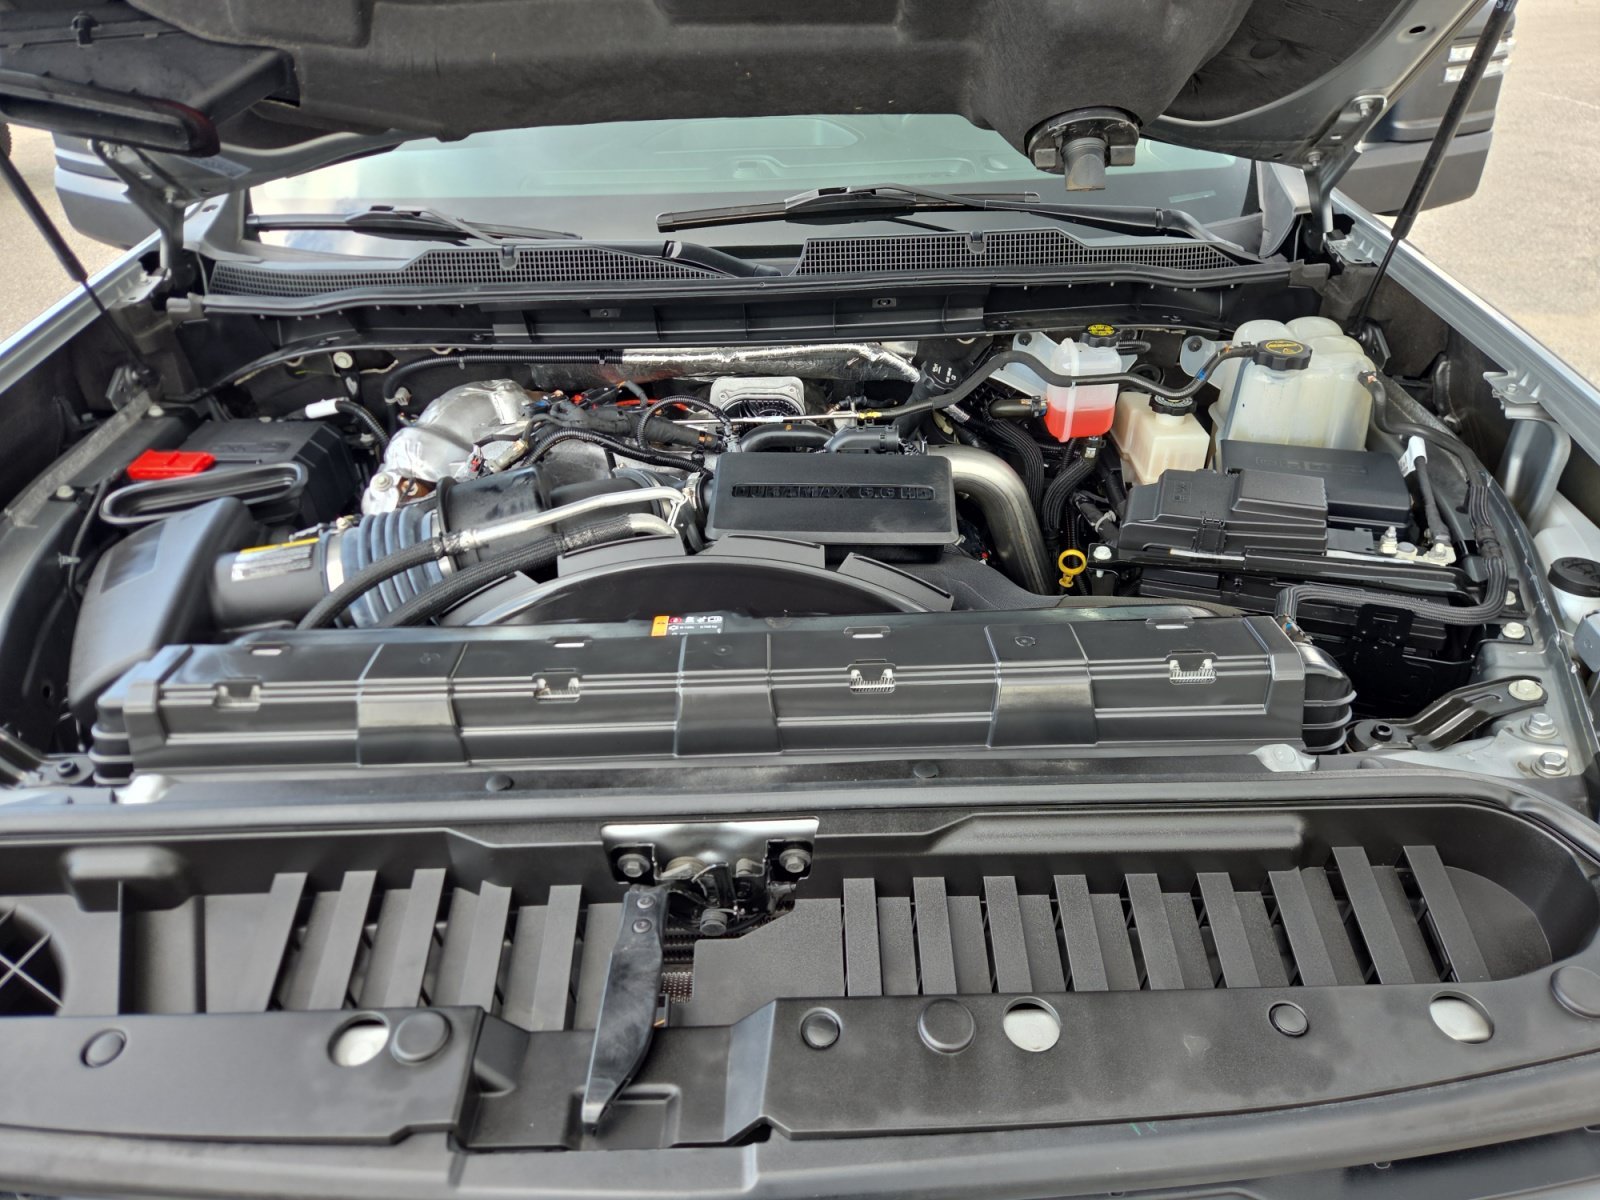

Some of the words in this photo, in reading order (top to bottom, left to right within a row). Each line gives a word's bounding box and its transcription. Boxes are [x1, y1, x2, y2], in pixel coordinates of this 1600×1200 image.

[733, 485, 850, 498] DURAMAX
[858, 486, 896, 499] 6.6
[900, 486, 933, 500] HD
